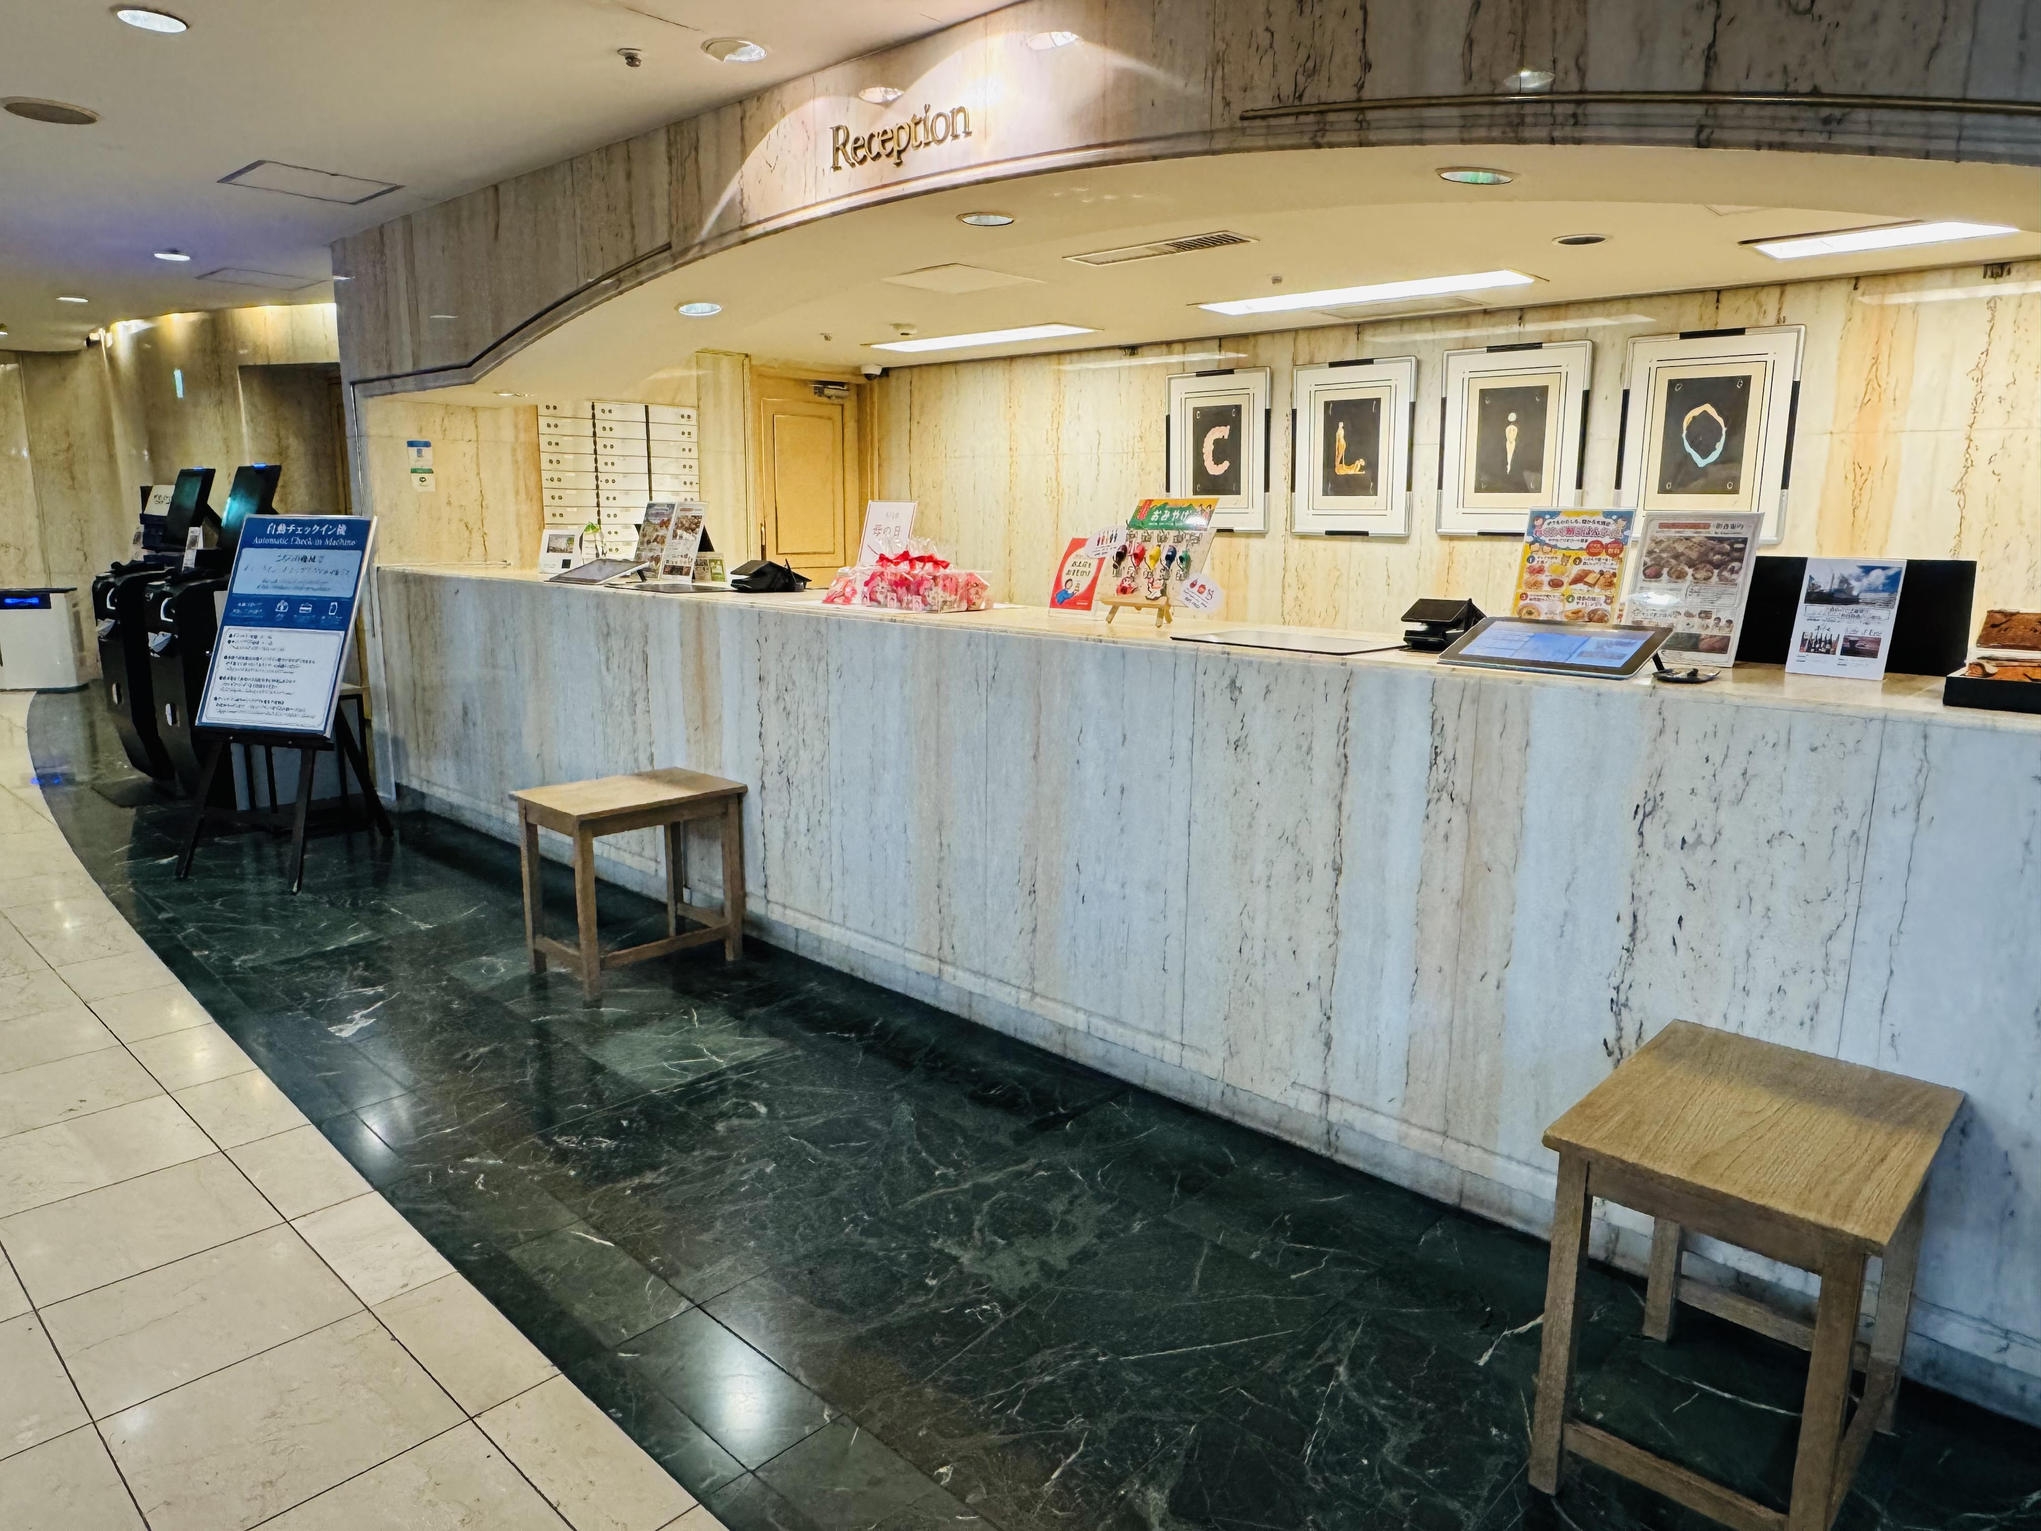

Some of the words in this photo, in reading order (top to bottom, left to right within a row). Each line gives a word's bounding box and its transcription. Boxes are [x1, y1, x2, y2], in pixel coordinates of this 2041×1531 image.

[831, 104, 973, 171] Reception
[1150, 509, 1192, 521] おみやげ
[266, 522, 347, 535] 自動チェックイン機
[252, 536, 288, 545] Automatic
